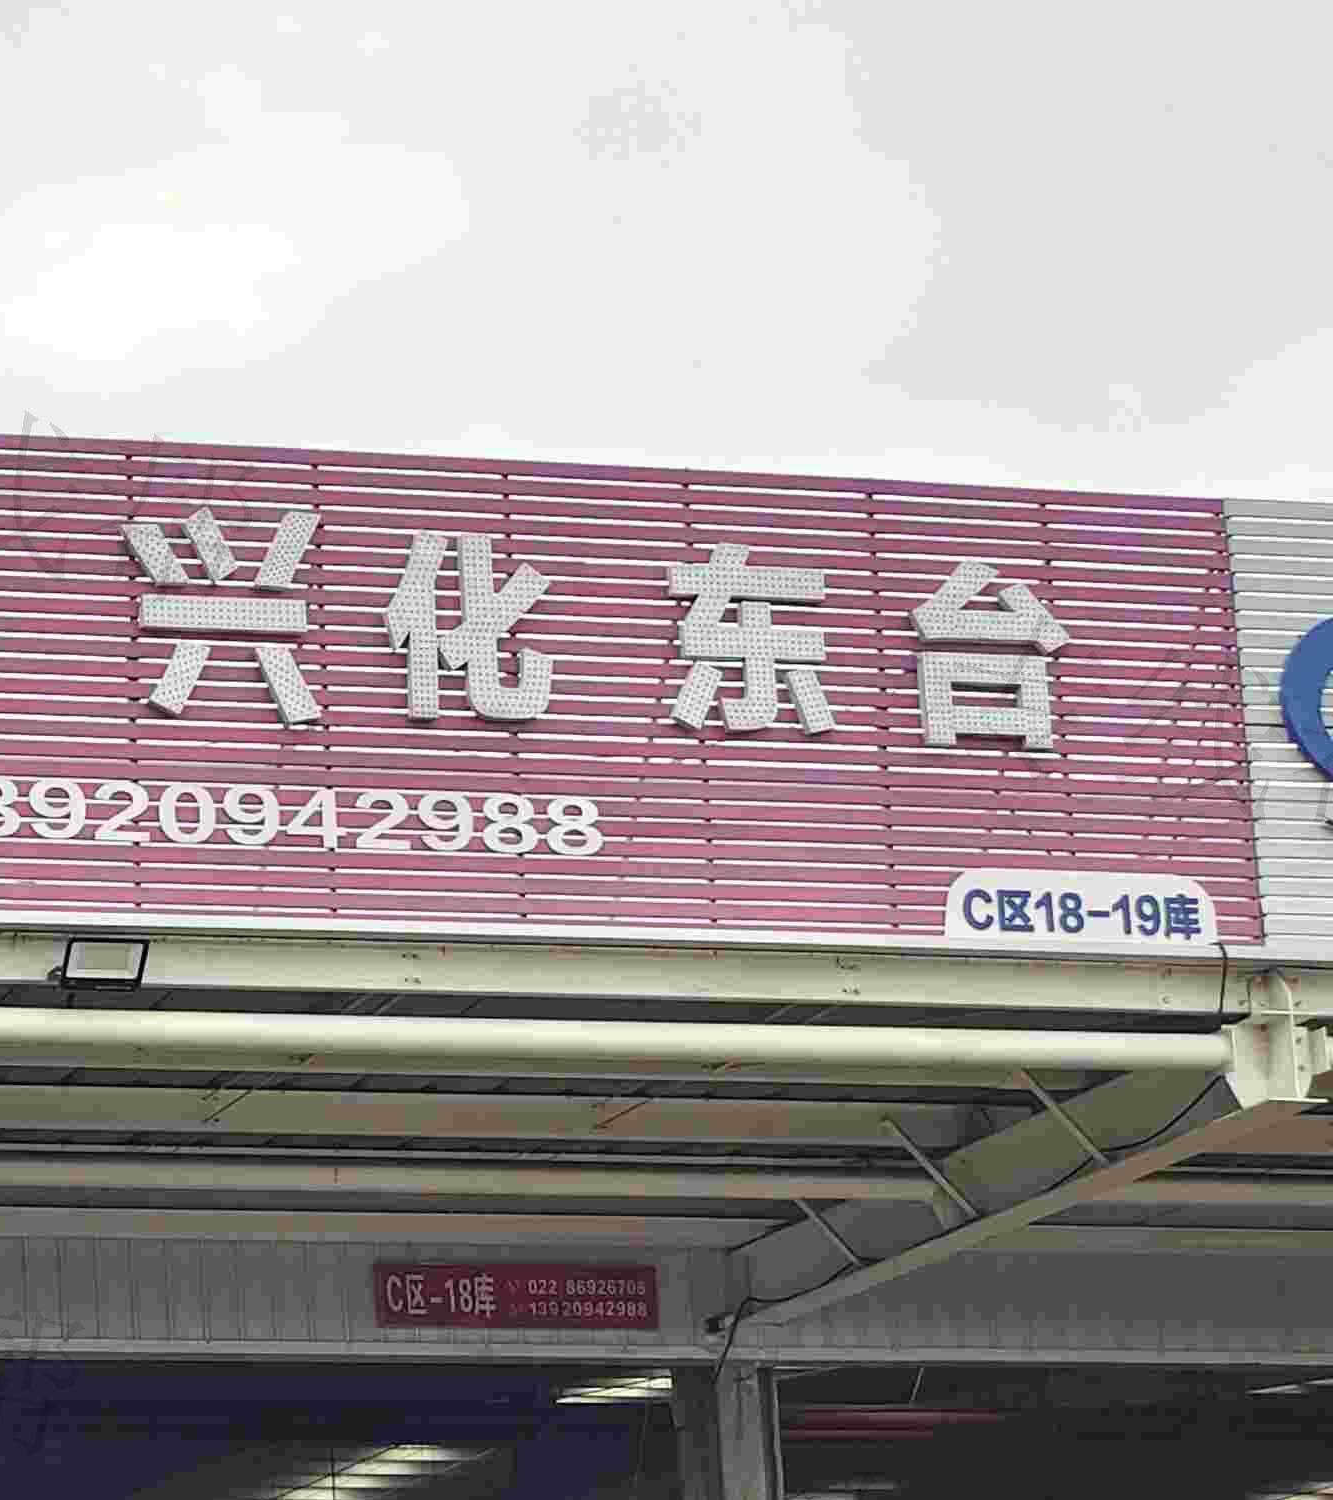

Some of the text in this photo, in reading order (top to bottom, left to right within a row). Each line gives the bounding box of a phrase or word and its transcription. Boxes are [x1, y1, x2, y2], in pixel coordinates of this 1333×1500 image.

[120, 507, 554, 728] 兴化
[667, 542, 1070, 750] 东台
[962, 888, 1202, 940] C区18-19库
[386, 1272, 497, 1320] C区-18库
